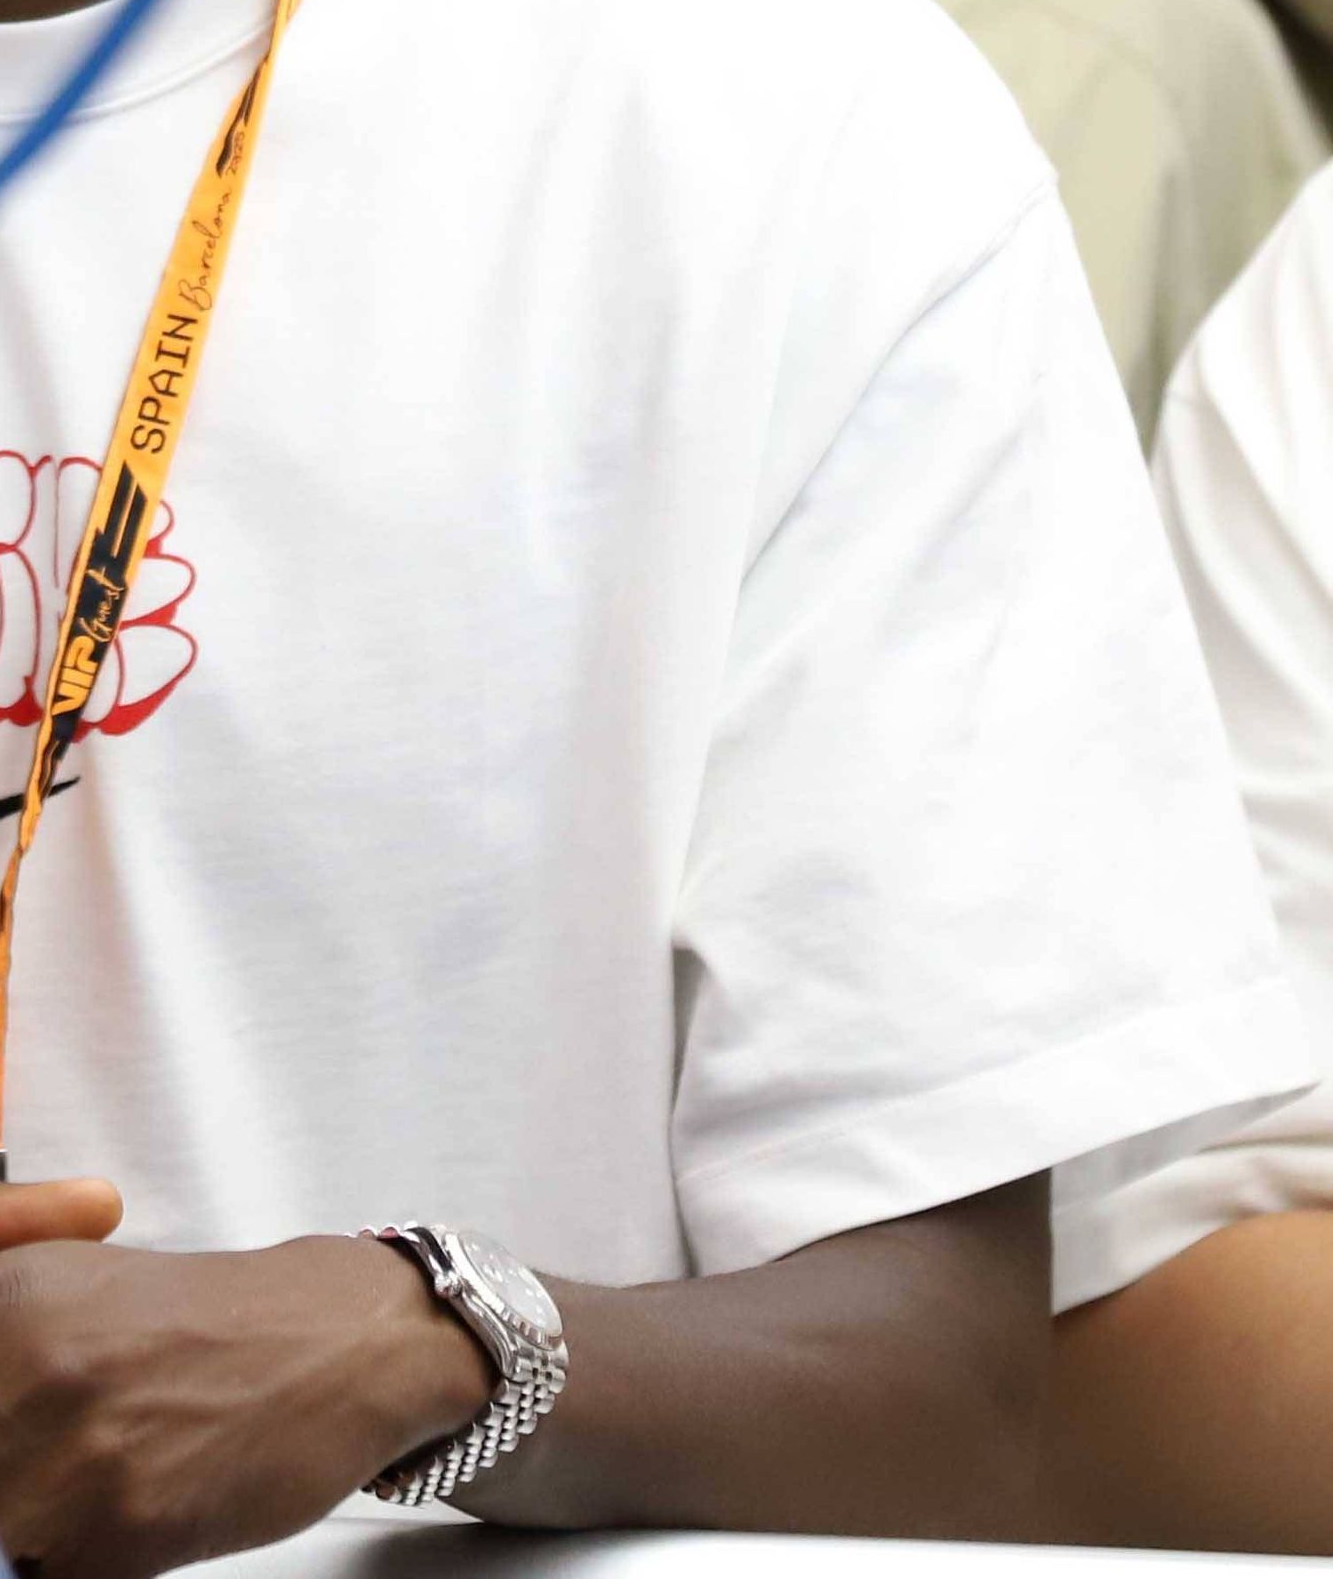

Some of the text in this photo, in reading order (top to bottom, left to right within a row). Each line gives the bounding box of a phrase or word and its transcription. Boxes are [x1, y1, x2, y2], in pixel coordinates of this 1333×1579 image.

[130, 313, 199, 455] SPAIN
[179, 188, 231, 311] Barcelona
[51, 565, 126, 718] VIP Guest
